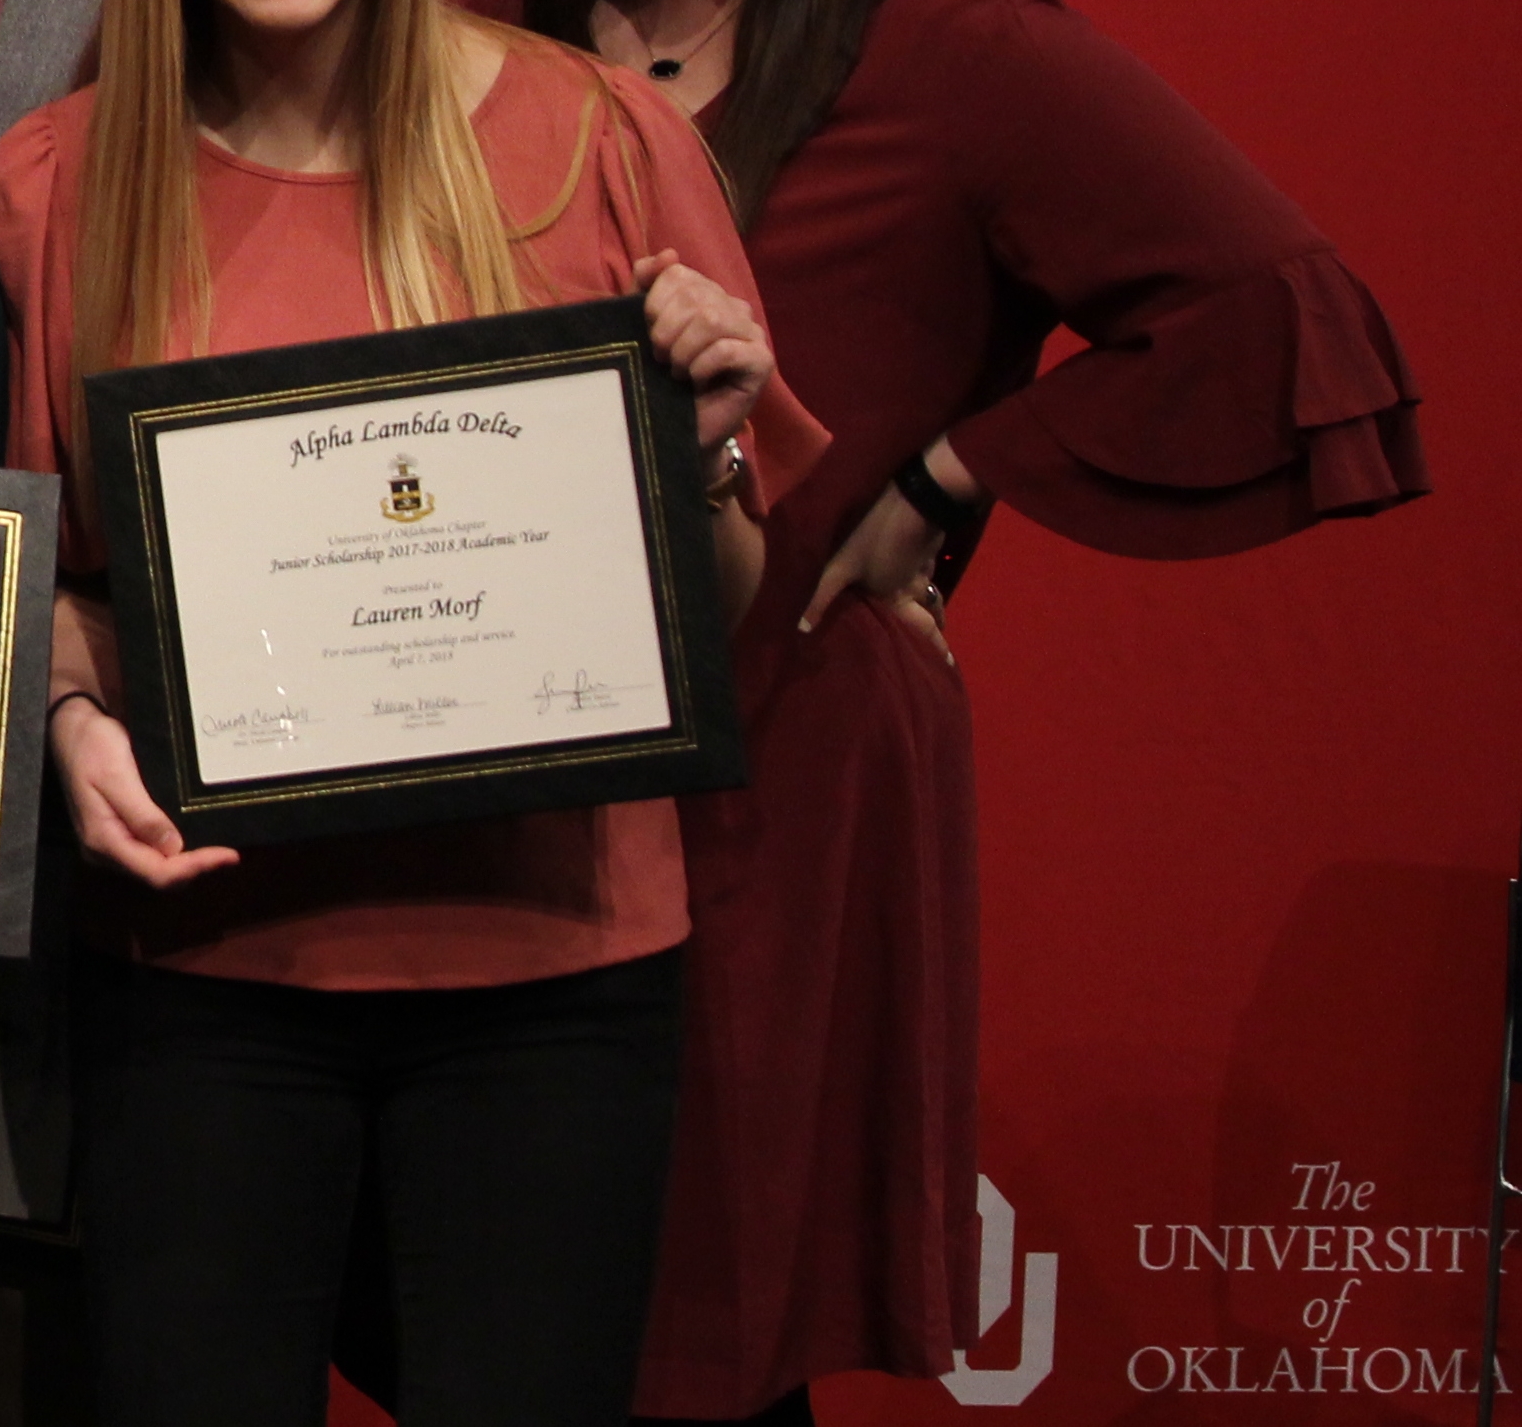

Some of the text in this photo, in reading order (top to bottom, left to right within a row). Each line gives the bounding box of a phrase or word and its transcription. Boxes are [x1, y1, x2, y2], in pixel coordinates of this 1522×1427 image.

[290, 411, 524, 467] Alpha Lambda Delta
[270, 529, 549, 573] Junior Scholarship 2017-2018 Academic Year
[351, 590, 486, 626] Lauren Morf
[1292, 1161, 1375, 1211] The
[1303, 1278, 1362, 1342] of
